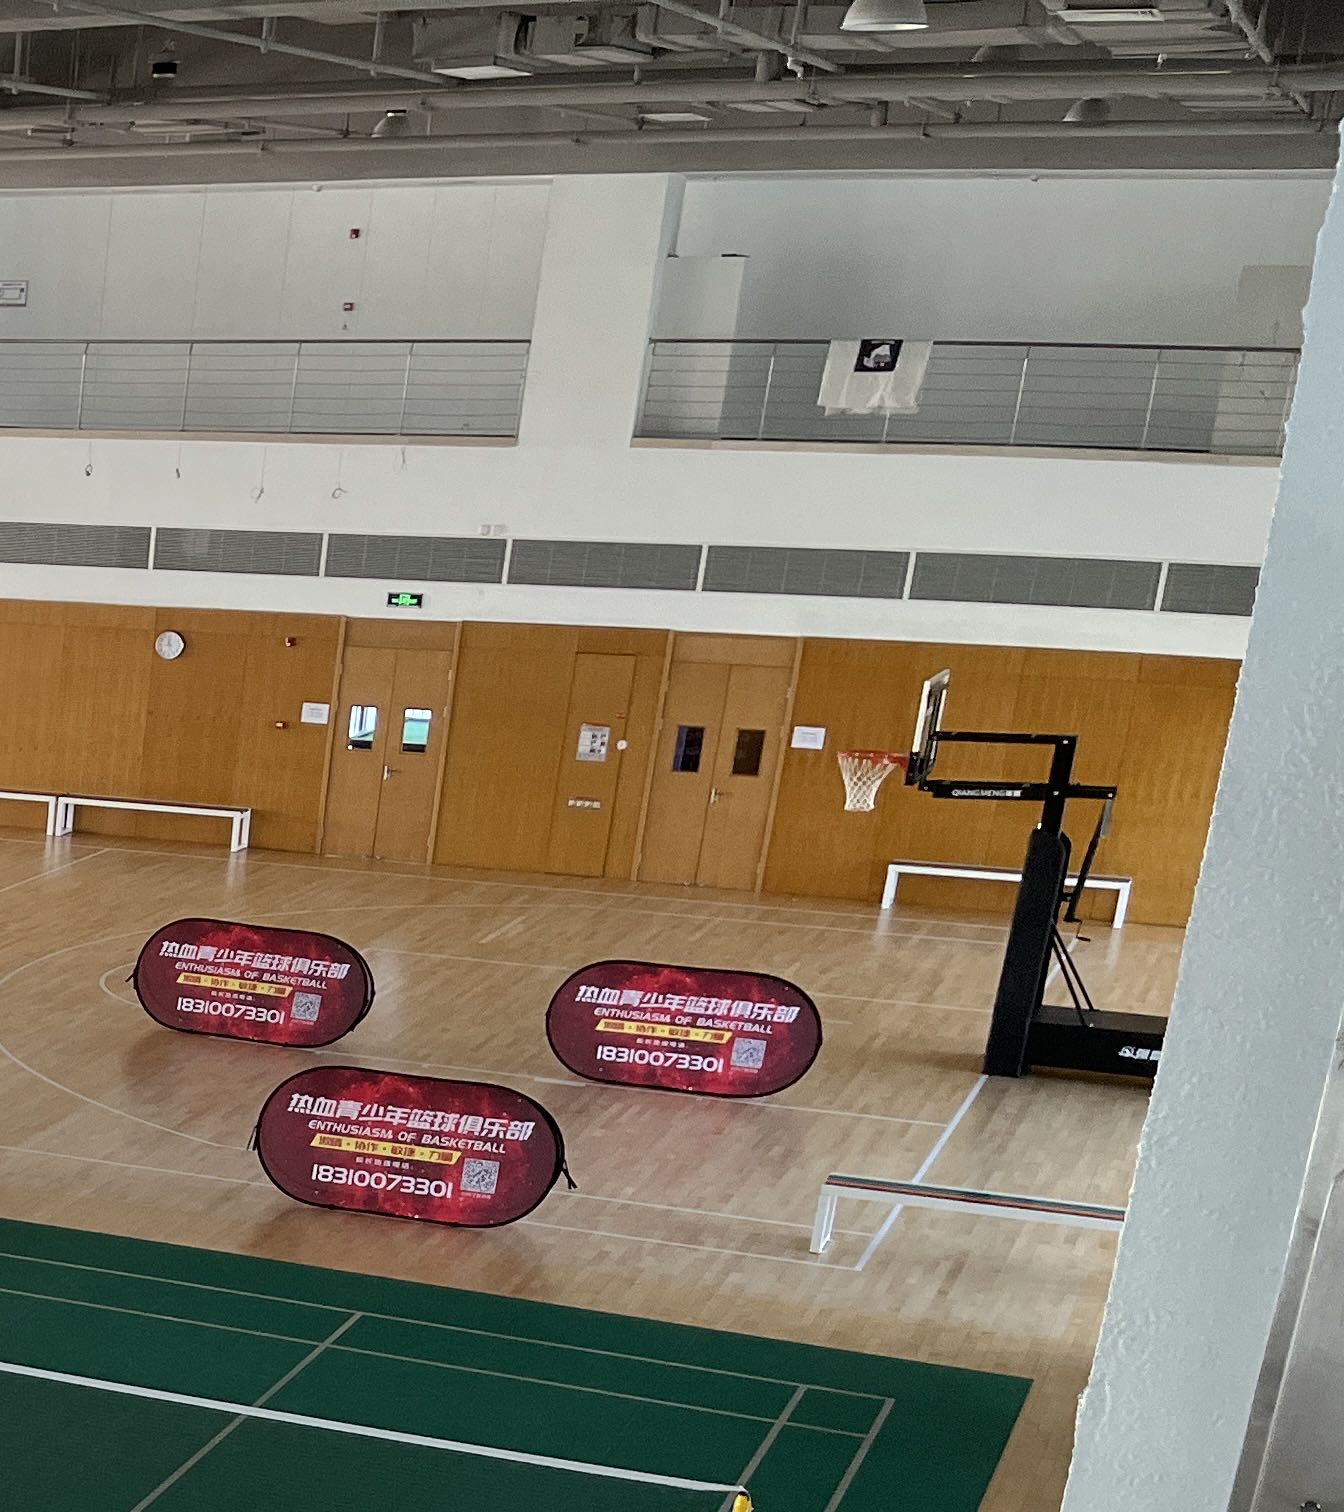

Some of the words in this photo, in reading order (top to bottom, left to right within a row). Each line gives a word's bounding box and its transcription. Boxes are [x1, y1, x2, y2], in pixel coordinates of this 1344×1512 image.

[159, 940, 351, 980] 热血青少年篮球俱乐部
[175, 961, 241, 978] ENTHUSIASM
[244, 970, 259, 980] OF
[262, 972, 327, 990] BASKETBALL
[176, 996, 285, 1025] 18310073301
[575, 985, 800, 1024] 热血青少年篮球俱乐部
[594, 1007, 670, 1024] ENTHUSIASM
[675, 1015, 692, 1026] OF
[696, 1017, 773, 1035] BASKETBALL
[596, 1045, 724, 1073] 18310073301
[287, 1093, 535, 1141] 热血青少年篮球俱乐部
[308, 1119, 393, 1140] ENTHUSIASM
[398, 1131, 417, 1143] OF
[421, 1134, 506, 1154] BASKETBALL
[311, 1163, 454, 1199] 18310073301
